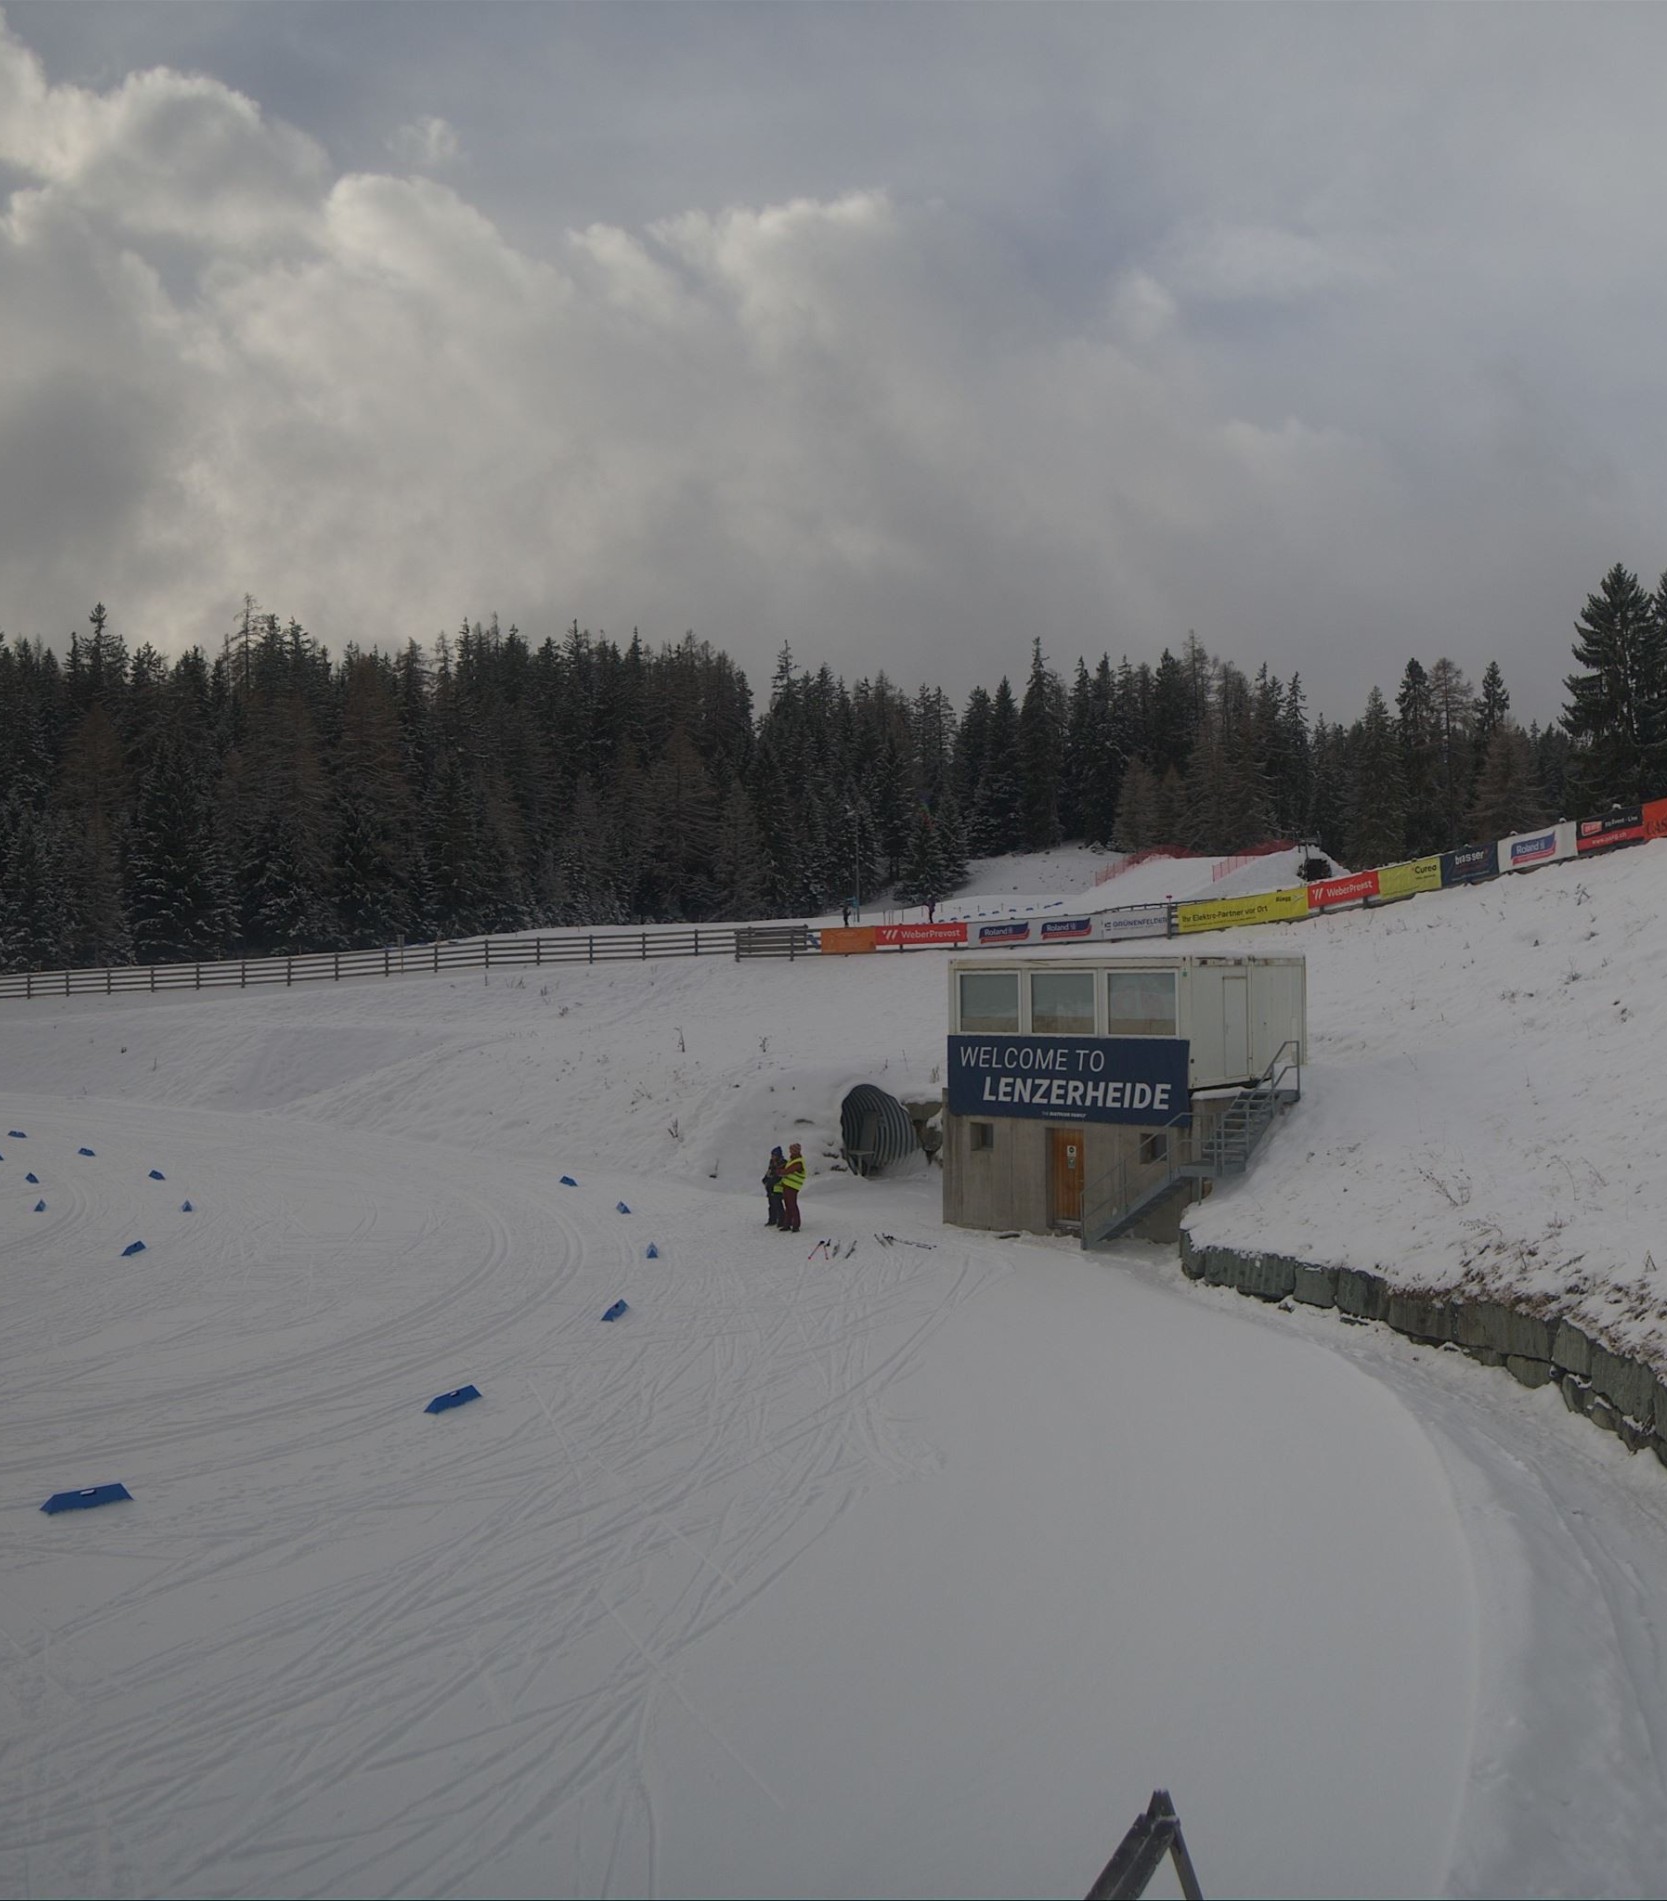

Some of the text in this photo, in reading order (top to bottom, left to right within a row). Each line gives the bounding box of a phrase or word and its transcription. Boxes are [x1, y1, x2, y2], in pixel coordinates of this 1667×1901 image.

[1516, 843, 1539, 855] Roland
[1182, 914, 1192, 923] Ihr
[1192, 908, 1244, 922] Elektro-Partner
[1244, 907, 1256, 915] vor
[1257, 905, 1268, 913] Ort
[983, 928, 1008, 936] Roland
[1046, 923, 1070, 932] Roland
[901, 930, 961, 939] WeberPrevost
[960, 1046, 1105, 1073] WELCOME TO
[982, 1076, 1172, 1110] LENZERHEIDE
